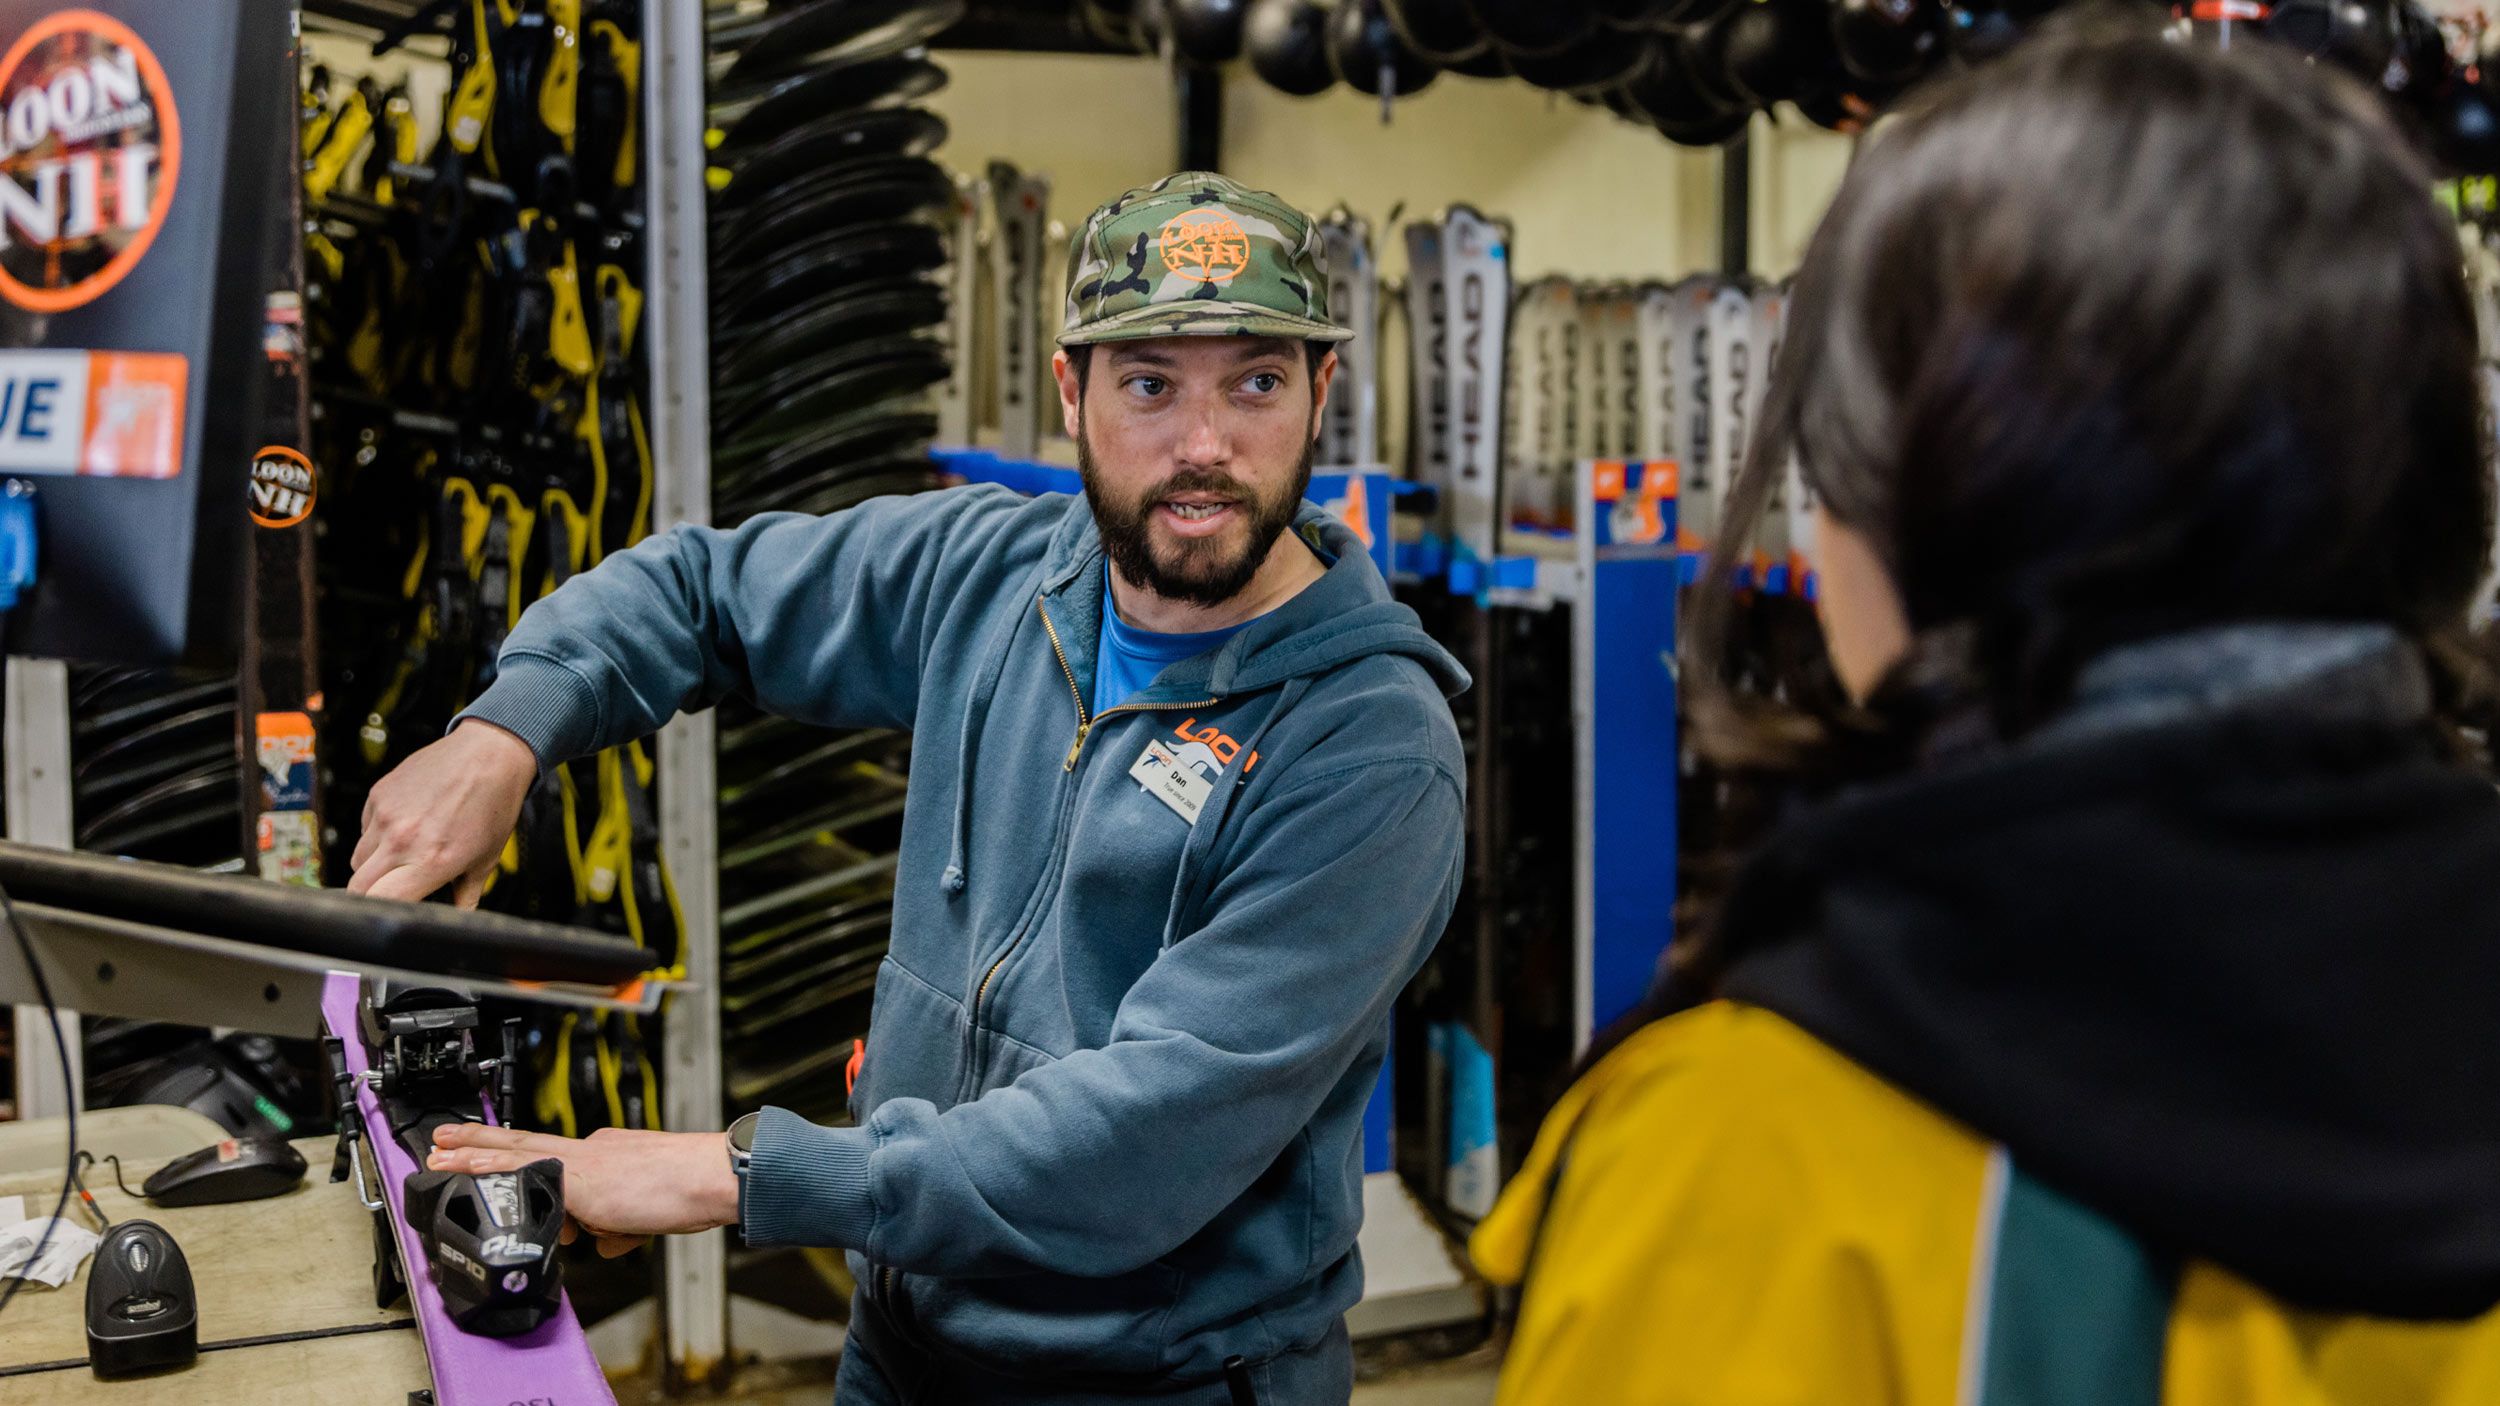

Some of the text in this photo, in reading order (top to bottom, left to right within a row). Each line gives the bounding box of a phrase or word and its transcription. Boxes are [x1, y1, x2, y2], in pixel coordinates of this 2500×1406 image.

[1462, 272, 1483, 479] HEAD
[1690, 326, 1709, 490] HEAD
[1170, 770, 1188, 788] Dan
[439, 1242, 486, 1281] SP10
